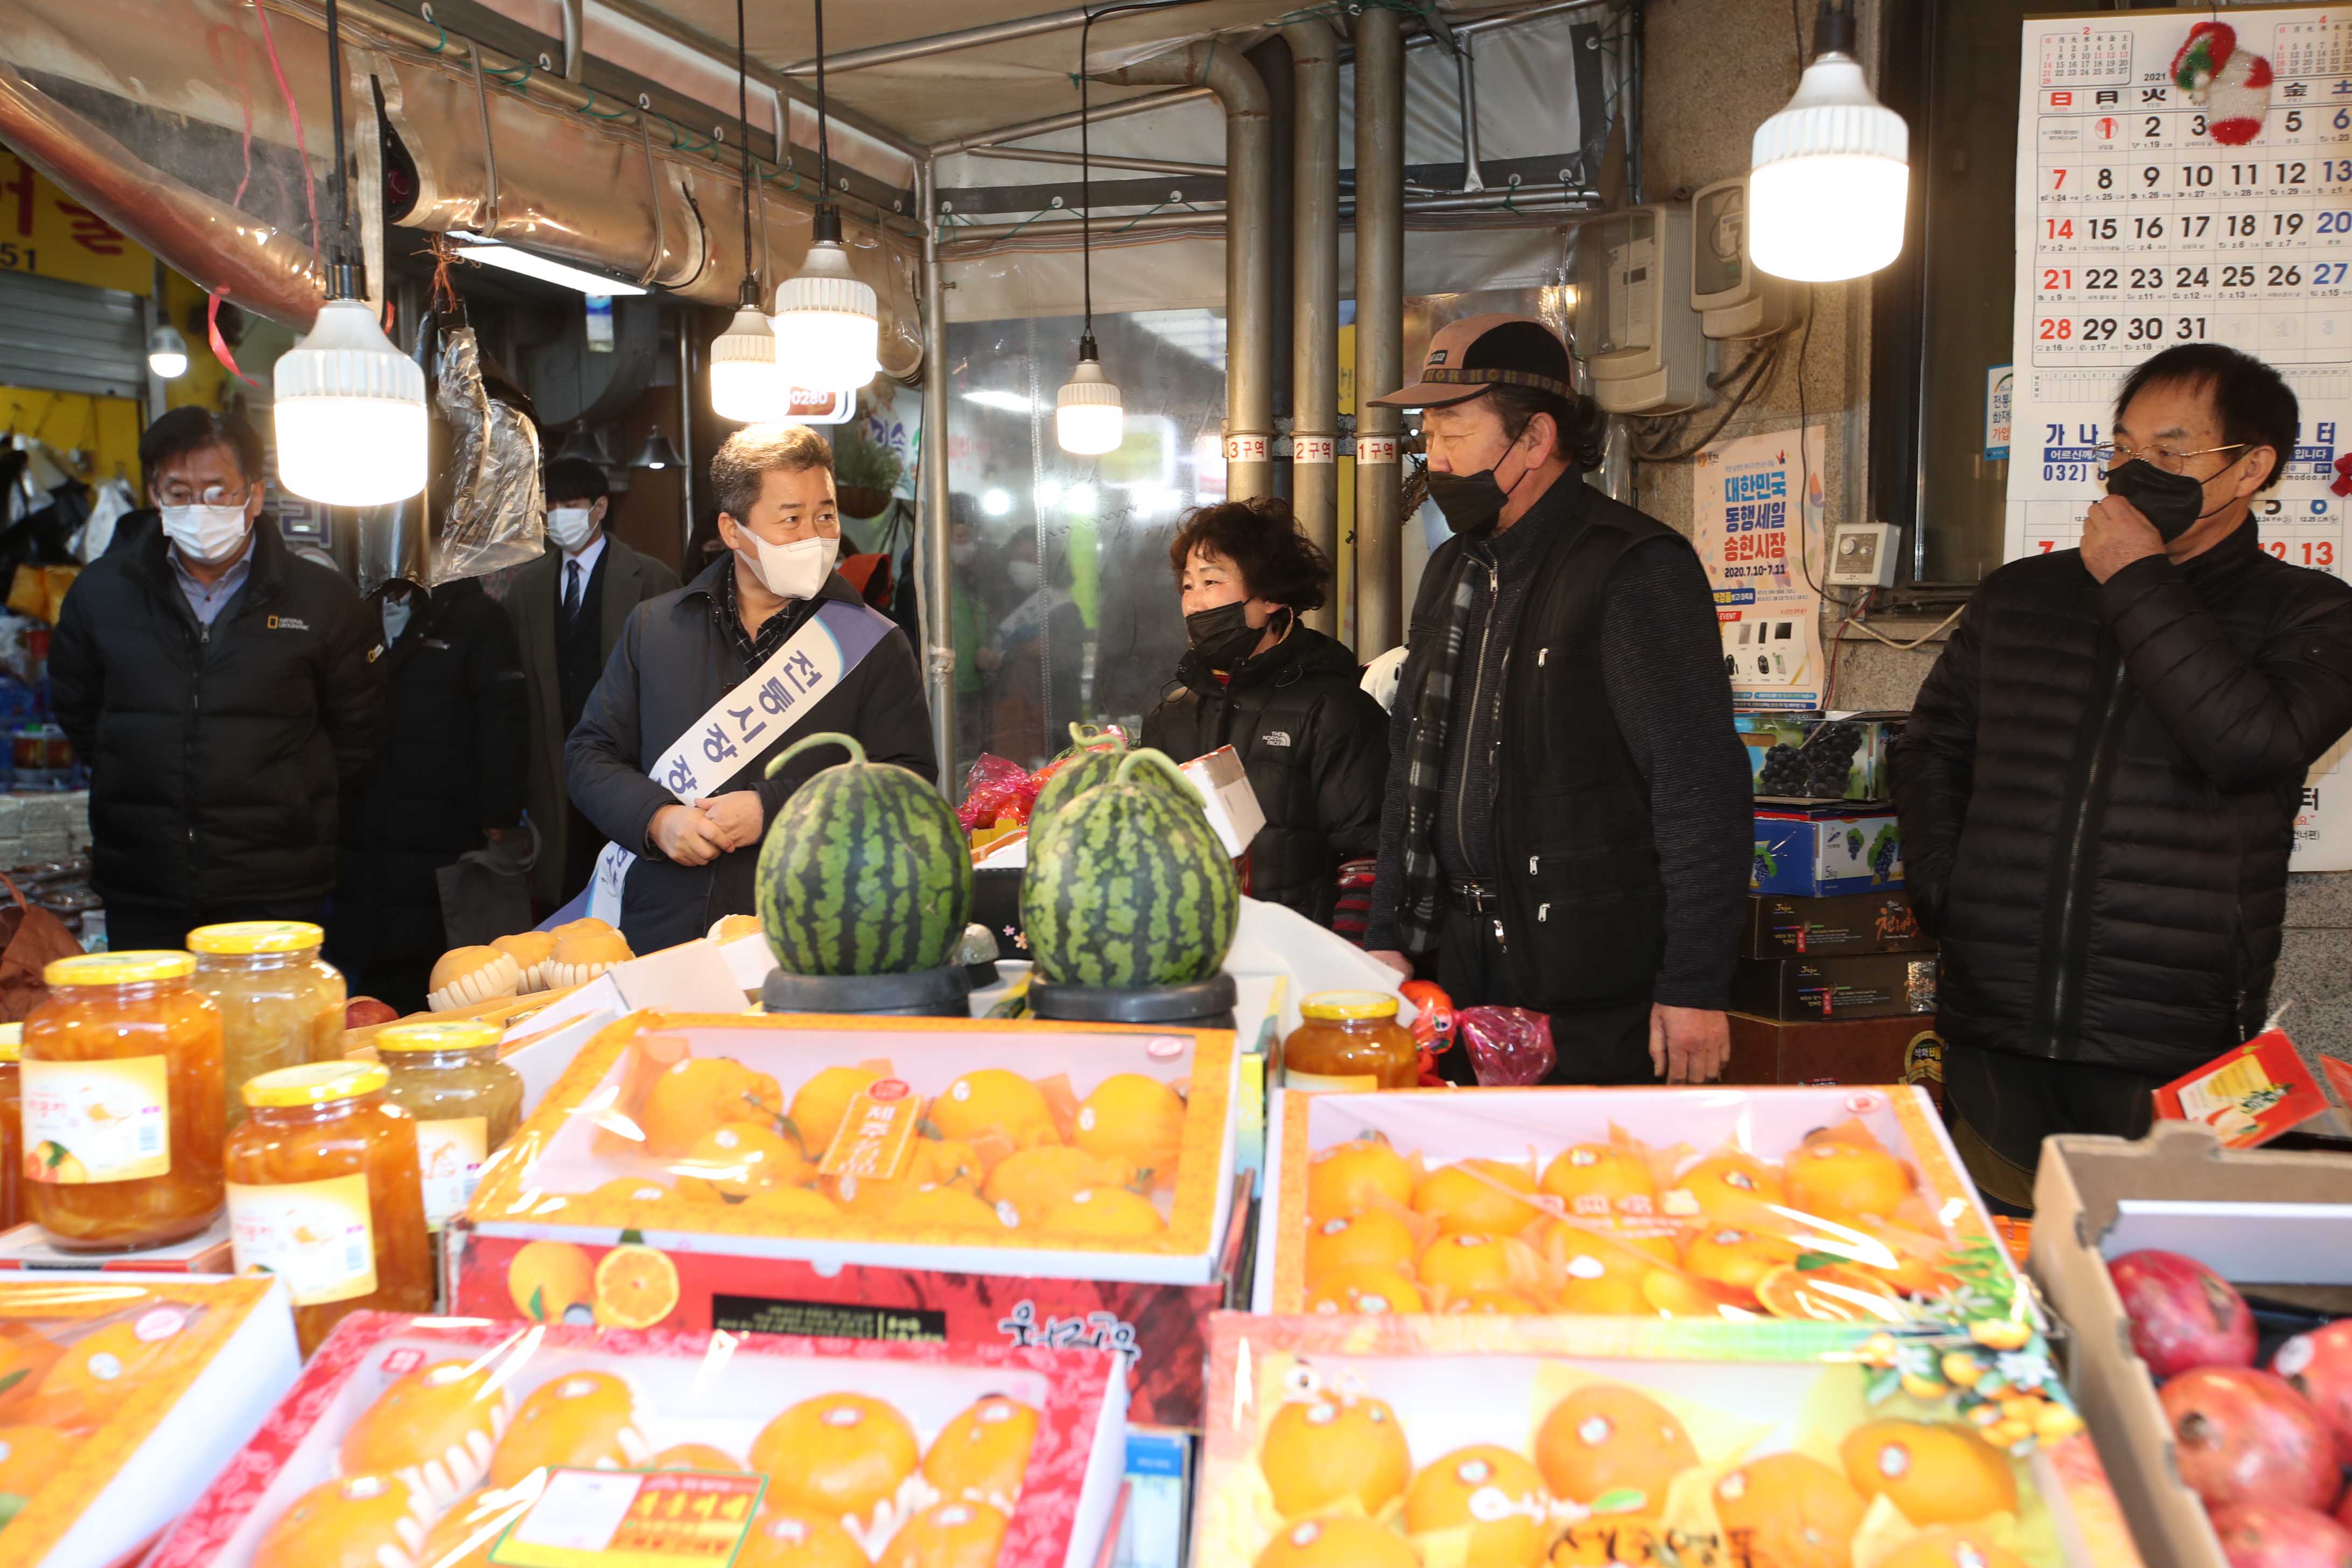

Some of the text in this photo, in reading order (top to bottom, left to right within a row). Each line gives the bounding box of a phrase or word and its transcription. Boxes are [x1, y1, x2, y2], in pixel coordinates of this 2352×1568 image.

[2319, 15, 2326, 23] 4
[2144, 73, 2165, 81] 2021
[2050, 80, 2352, 106] 日 月 火 金 土
[2145, 116, 2160, 137] 2
[2192, 115, 2206, 136] 3
[2285, 111, 2302, 132] 5
[2334, 108, 2350, 129] 6
[2053, 160, 2352, 190] 7 8 9 10 11 12 13
[2046, 212, 2352, 239] 14 15 16 17 18 19 20
[2044, 263, 2348, 290] 21 22 23 24 25 26 27
[2040, 318, 2206, 340] 28 29 30 31
[1993, 410, 2012, 423] 화재
[1725, 471, 1786, 502] 대한민국
[2043, 464, 2086, 482] 032)
[1726, 502, 1786, 533] 동행세일
[1724, 532, 1786, 562] 송현시장
[2301, 542, 2333, 565] 13
[703, 649, 823, 764] 전통시장
